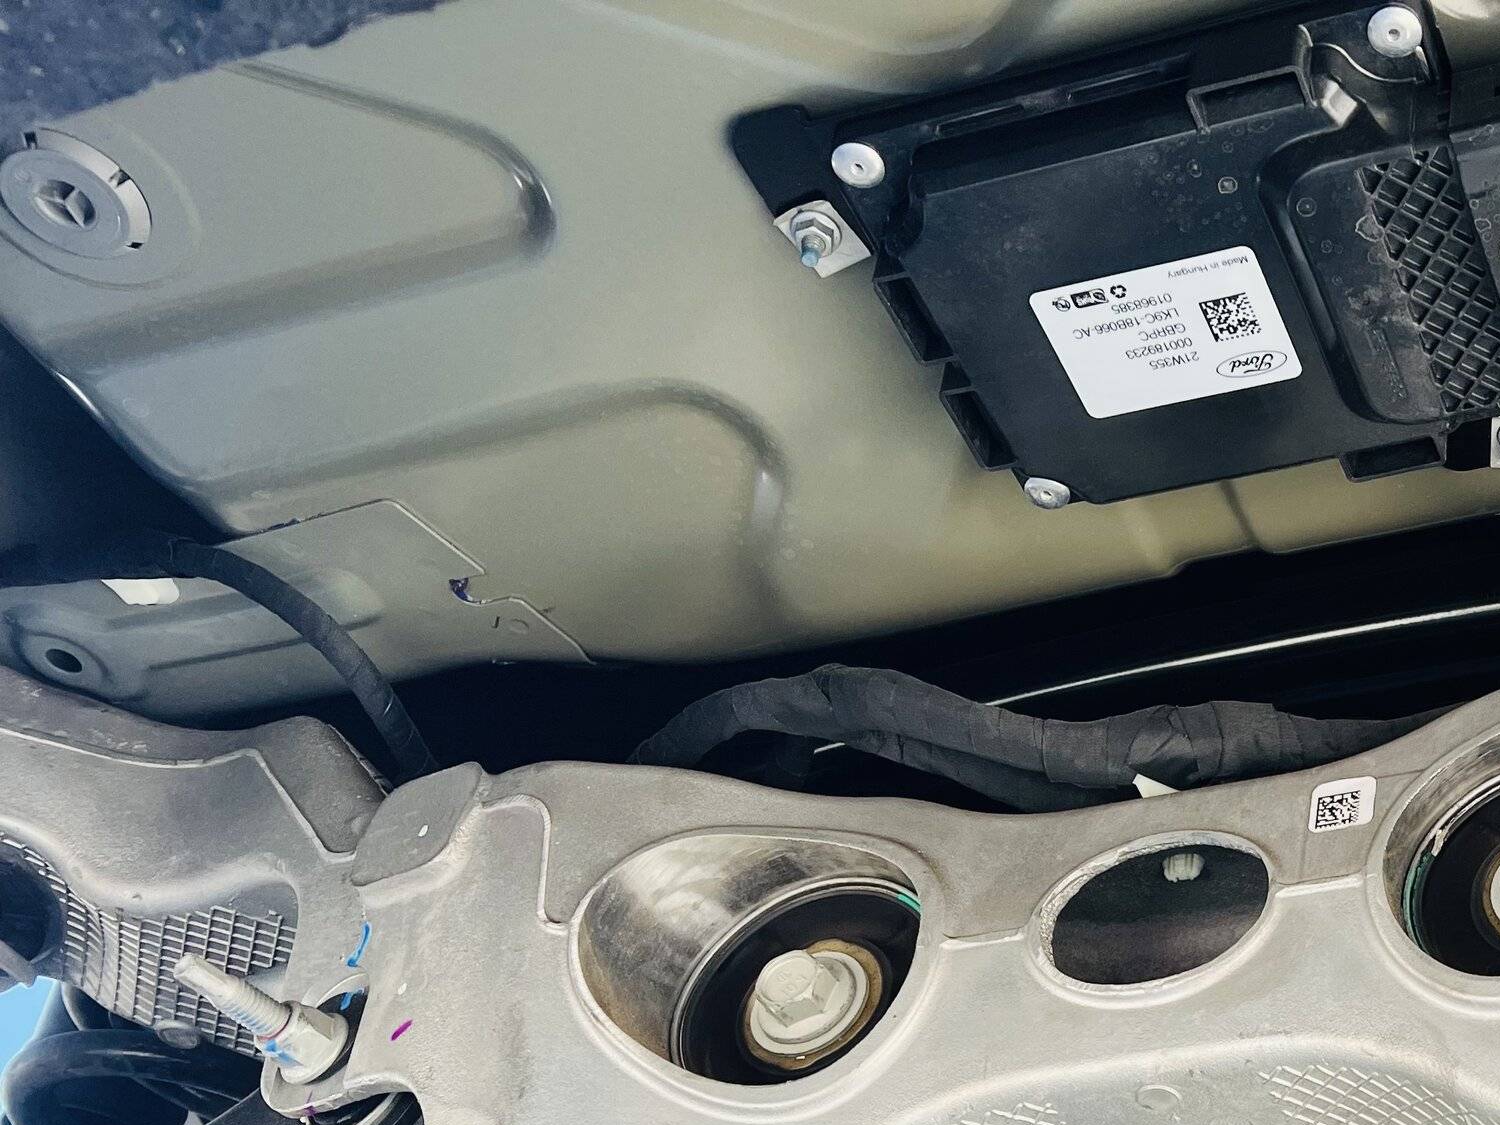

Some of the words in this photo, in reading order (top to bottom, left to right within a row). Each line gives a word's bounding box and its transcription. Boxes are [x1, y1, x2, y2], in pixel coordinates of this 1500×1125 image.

[1208, 262, 1219, 271] in
[1221, 255, 1248, 267] Made
[1167, 264, 1208, 279] Hungary
[1072, 308, 1180, 340] LK9C-18B066-AC
[1138, 322, 1187, 342] GBRPC
[1125, 337, 1193, 360] 000189233
[1149, 350, 1200, 371] 21W355
[1229, 353, 1274, 374] Ford
